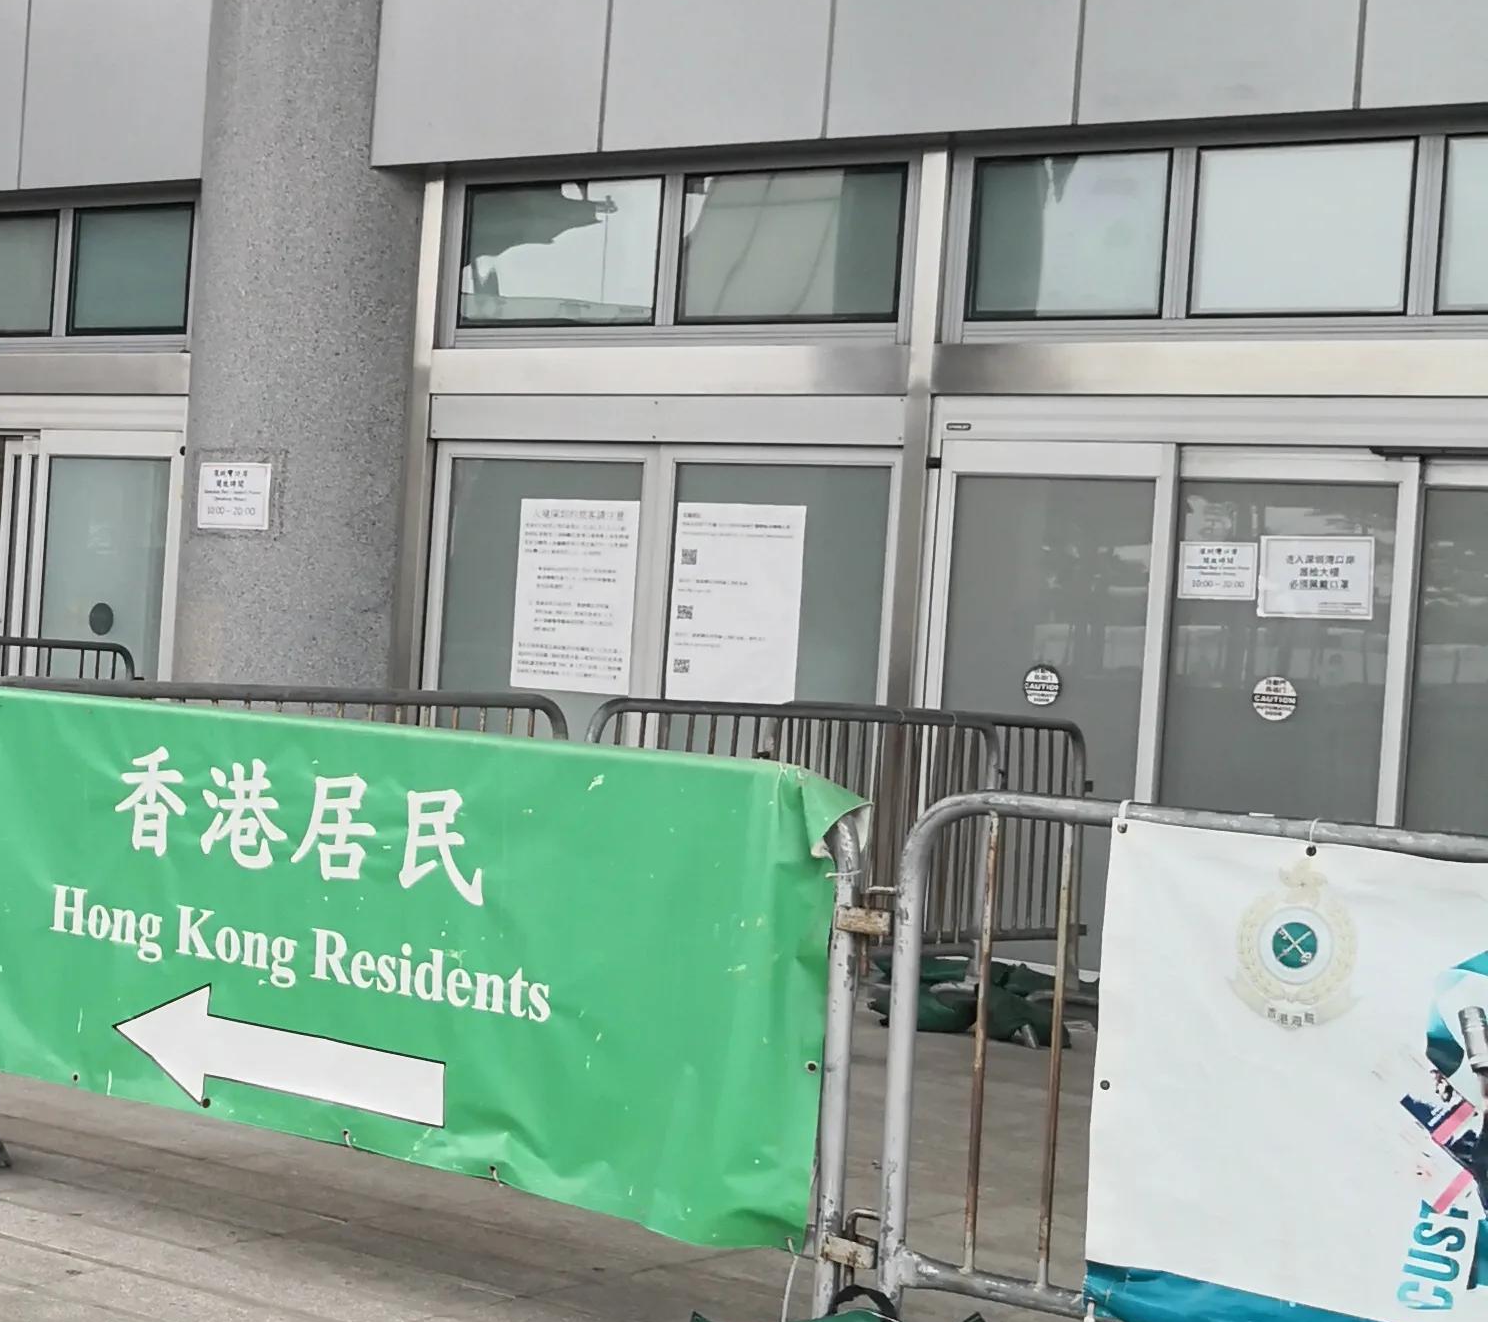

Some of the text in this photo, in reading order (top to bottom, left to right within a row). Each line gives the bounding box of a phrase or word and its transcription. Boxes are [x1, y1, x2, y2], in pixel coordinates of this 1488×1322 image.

[1254, 694, 1297, 705] CAUTION
[114, 746, 484, 907] 香港居民
[49, 883, 551, 1022] Hong Kong Residents
